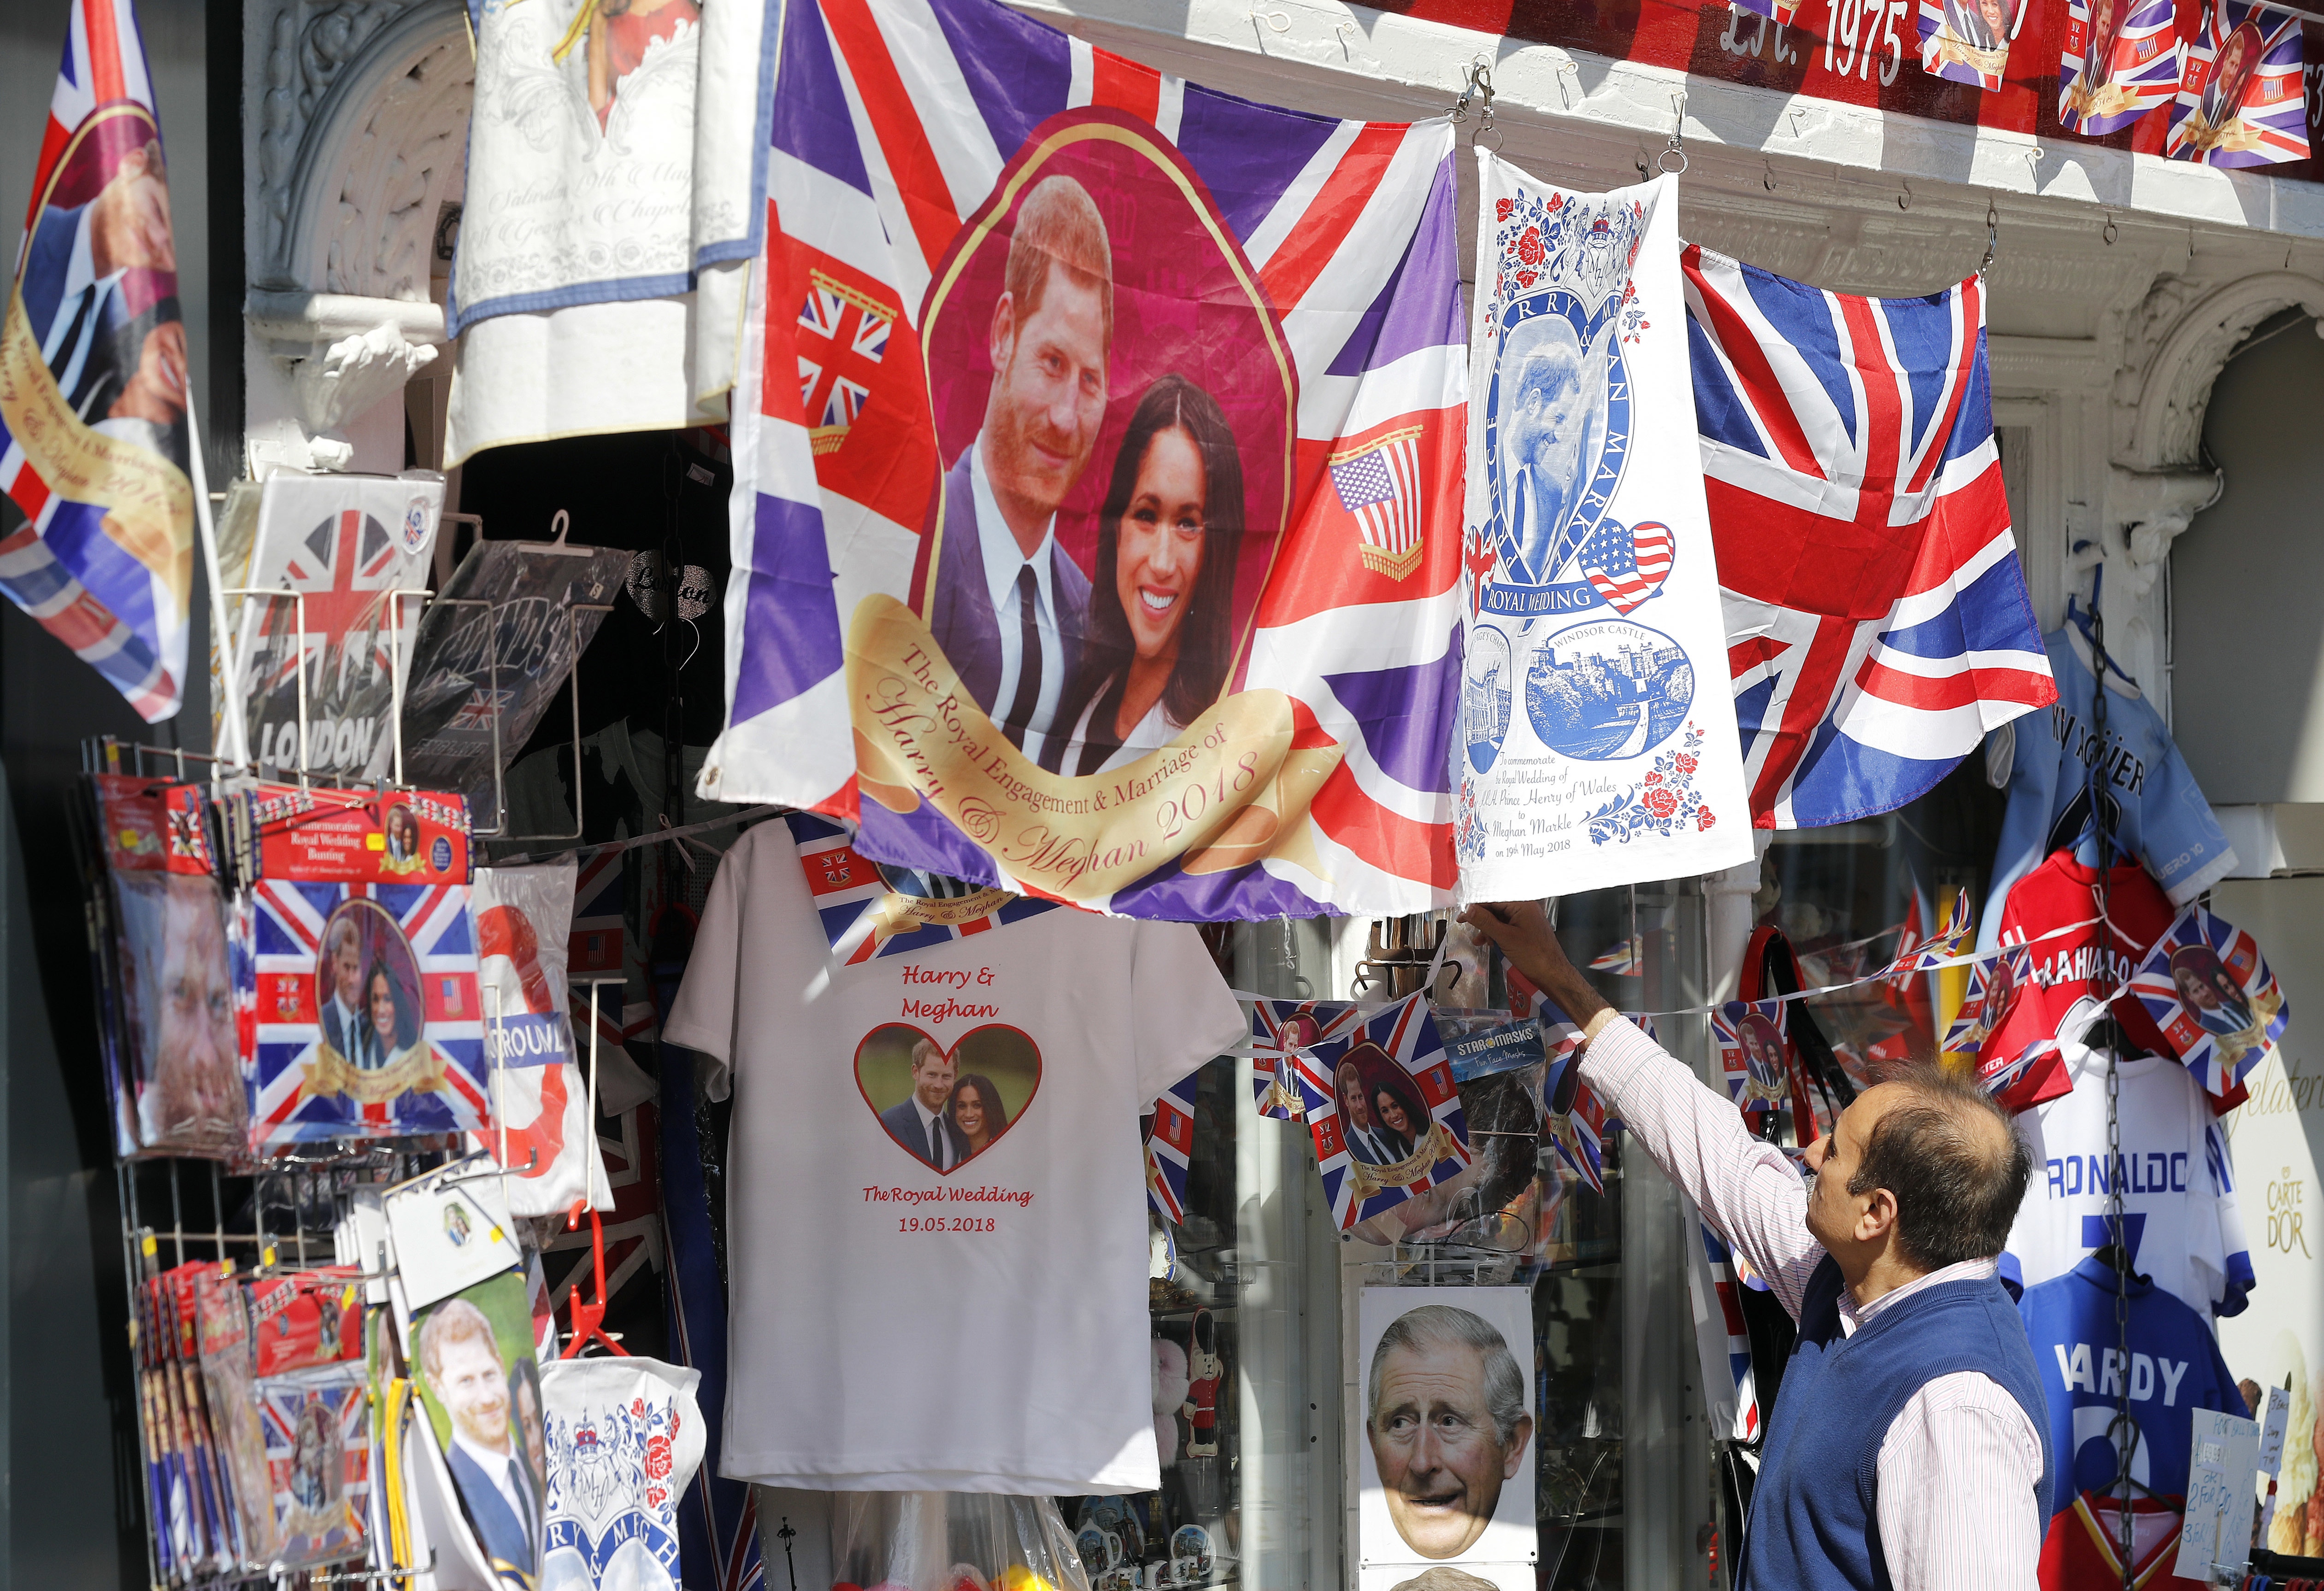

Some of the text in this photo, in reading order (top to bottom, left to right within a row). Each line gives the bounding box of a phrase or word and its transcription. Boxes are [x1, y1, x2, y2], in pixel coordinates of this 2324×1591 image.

[1824, 0, 1908, 87] 1975
[1580, 325, 1592, 346] &
[1489, 587, 1591, 612] ROYAL WEDDING
[1554, 625, 1646, 648] WINDSOR CASTLE
[901, 642, 1228, 815] The Royal Engagement & Marriage of
[261, 717, 376, 769] LONDON
[1508, 755, 1556, 765] commemorate
[866, 675, 1258, 892] Harry & Meghan 2018
[1517, 771, 1557, 785] Wedding
[1559, 767, 1570, 783] of
[1500, 790, 1520, 806] Prince
[1524, 787, 1561, 806] Henry
[1565, 782, 1577, 802] of
[1579, 776, 1617, 796] Wales
[1493, 814, 1571, 838] Meghan Markle
[1518, 810, 1525, 820] to
[290, 833, 361, 850] Royal Wedding
[1495, 840, 1571, 858] on 19th May 2018
[307, 847, 346, 863] Bunting
[899, 897, 1003, 922] Harry & Meghan
[916, 899, 936, 907] Royal
[938, 896, 981, 908] Engagement
[902, 965, 994, 989] Harry &
[901, 998, 999, 1023] Meghan
[1475, 1048, 1526, 1067] Fun Face Masks
[1363, 1136, 1440, 1186] Harry & Meghan 2018
[1388, 1157, 1418, 1172] Engagement
[1420, 1136, 1432, 1156] Marriage
[2047, 1152, 2186, 1200] RONALDO
[863, 1186, 1034, 1207] The Royal Wedding
[2268, 1180, 2303, 1212] CARTE
[899, 1217, 995, 1233] 19.05.2018
[2268, 1210, 2312, 1260] D'OR
[2053, 1343, 2189, 1407] VARDY
[2181, 1524, 2193, 1544] 3
[589, 1552, 604, 1579] &
